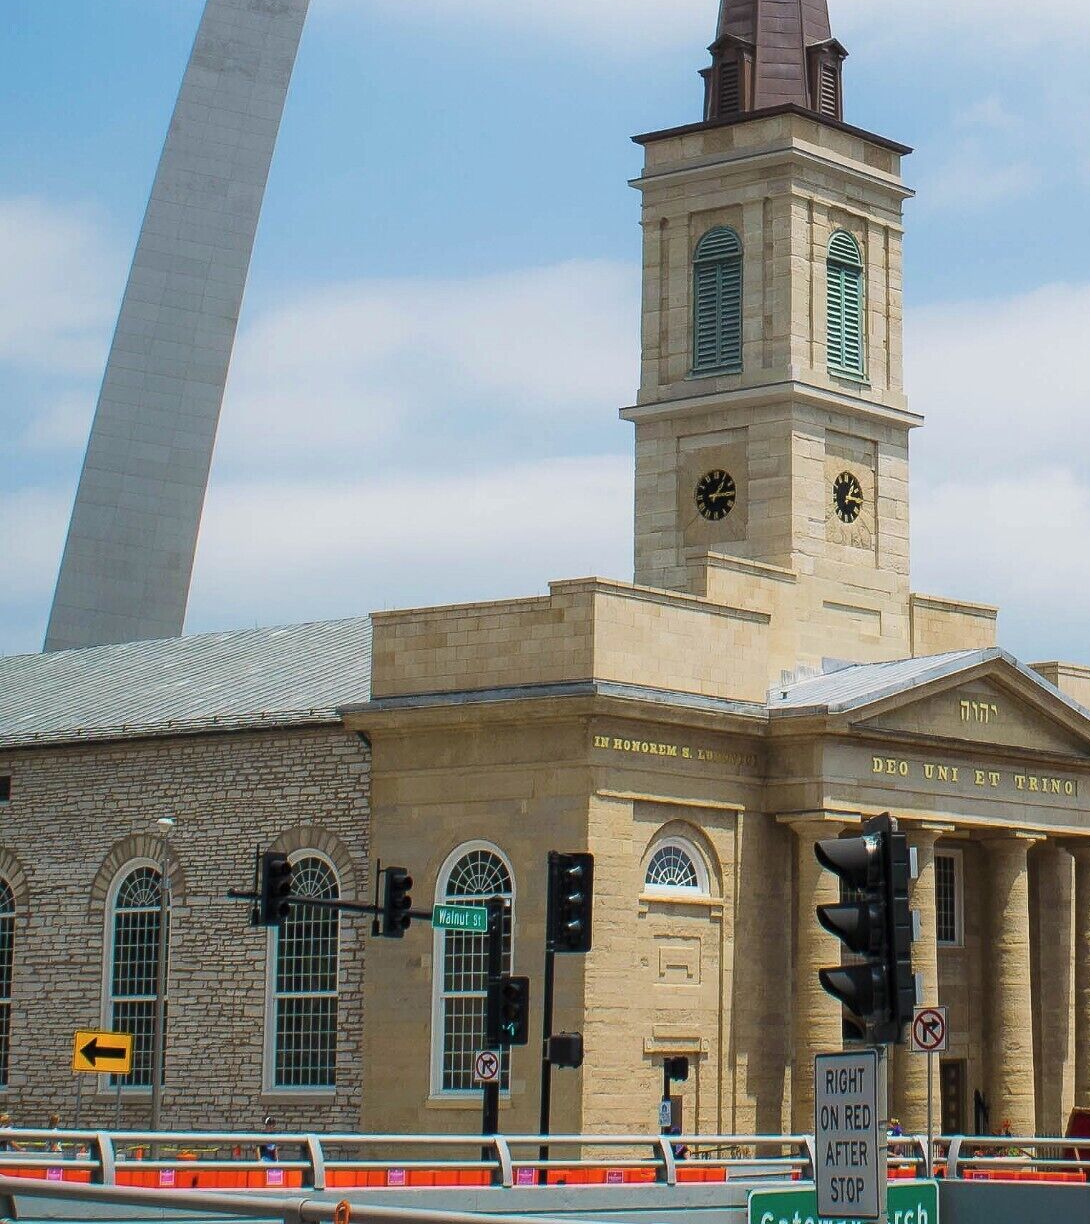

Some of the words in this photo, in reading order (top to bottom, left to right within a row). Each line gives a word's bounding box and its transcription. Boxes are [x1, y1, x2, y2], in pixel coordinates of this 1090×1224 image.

[959, 700, 998, 724] יהוה
[594, 735, 609, 749] IN
[613, 738, 677, 757] HONOREM
[872, 756, 909, 776] DEO
[924, 764, 959, 783] UNI
[974, 770, 1000, 787] ET
[1014, 775, 1074, 796] TRINO
[439, 909, 469, 926] Walnut
[473, 913, 481, 927] St
[825, 1067, 865, 1095] RIGHT
[820, 1104, 839, 1130] ON
[844, 1104, 871, 1130] RED
[826, 1140, 868, 1167] AFTER
[830, 1176, 865, 1203] STOP
[887, 1202, 928, 1224] rch
